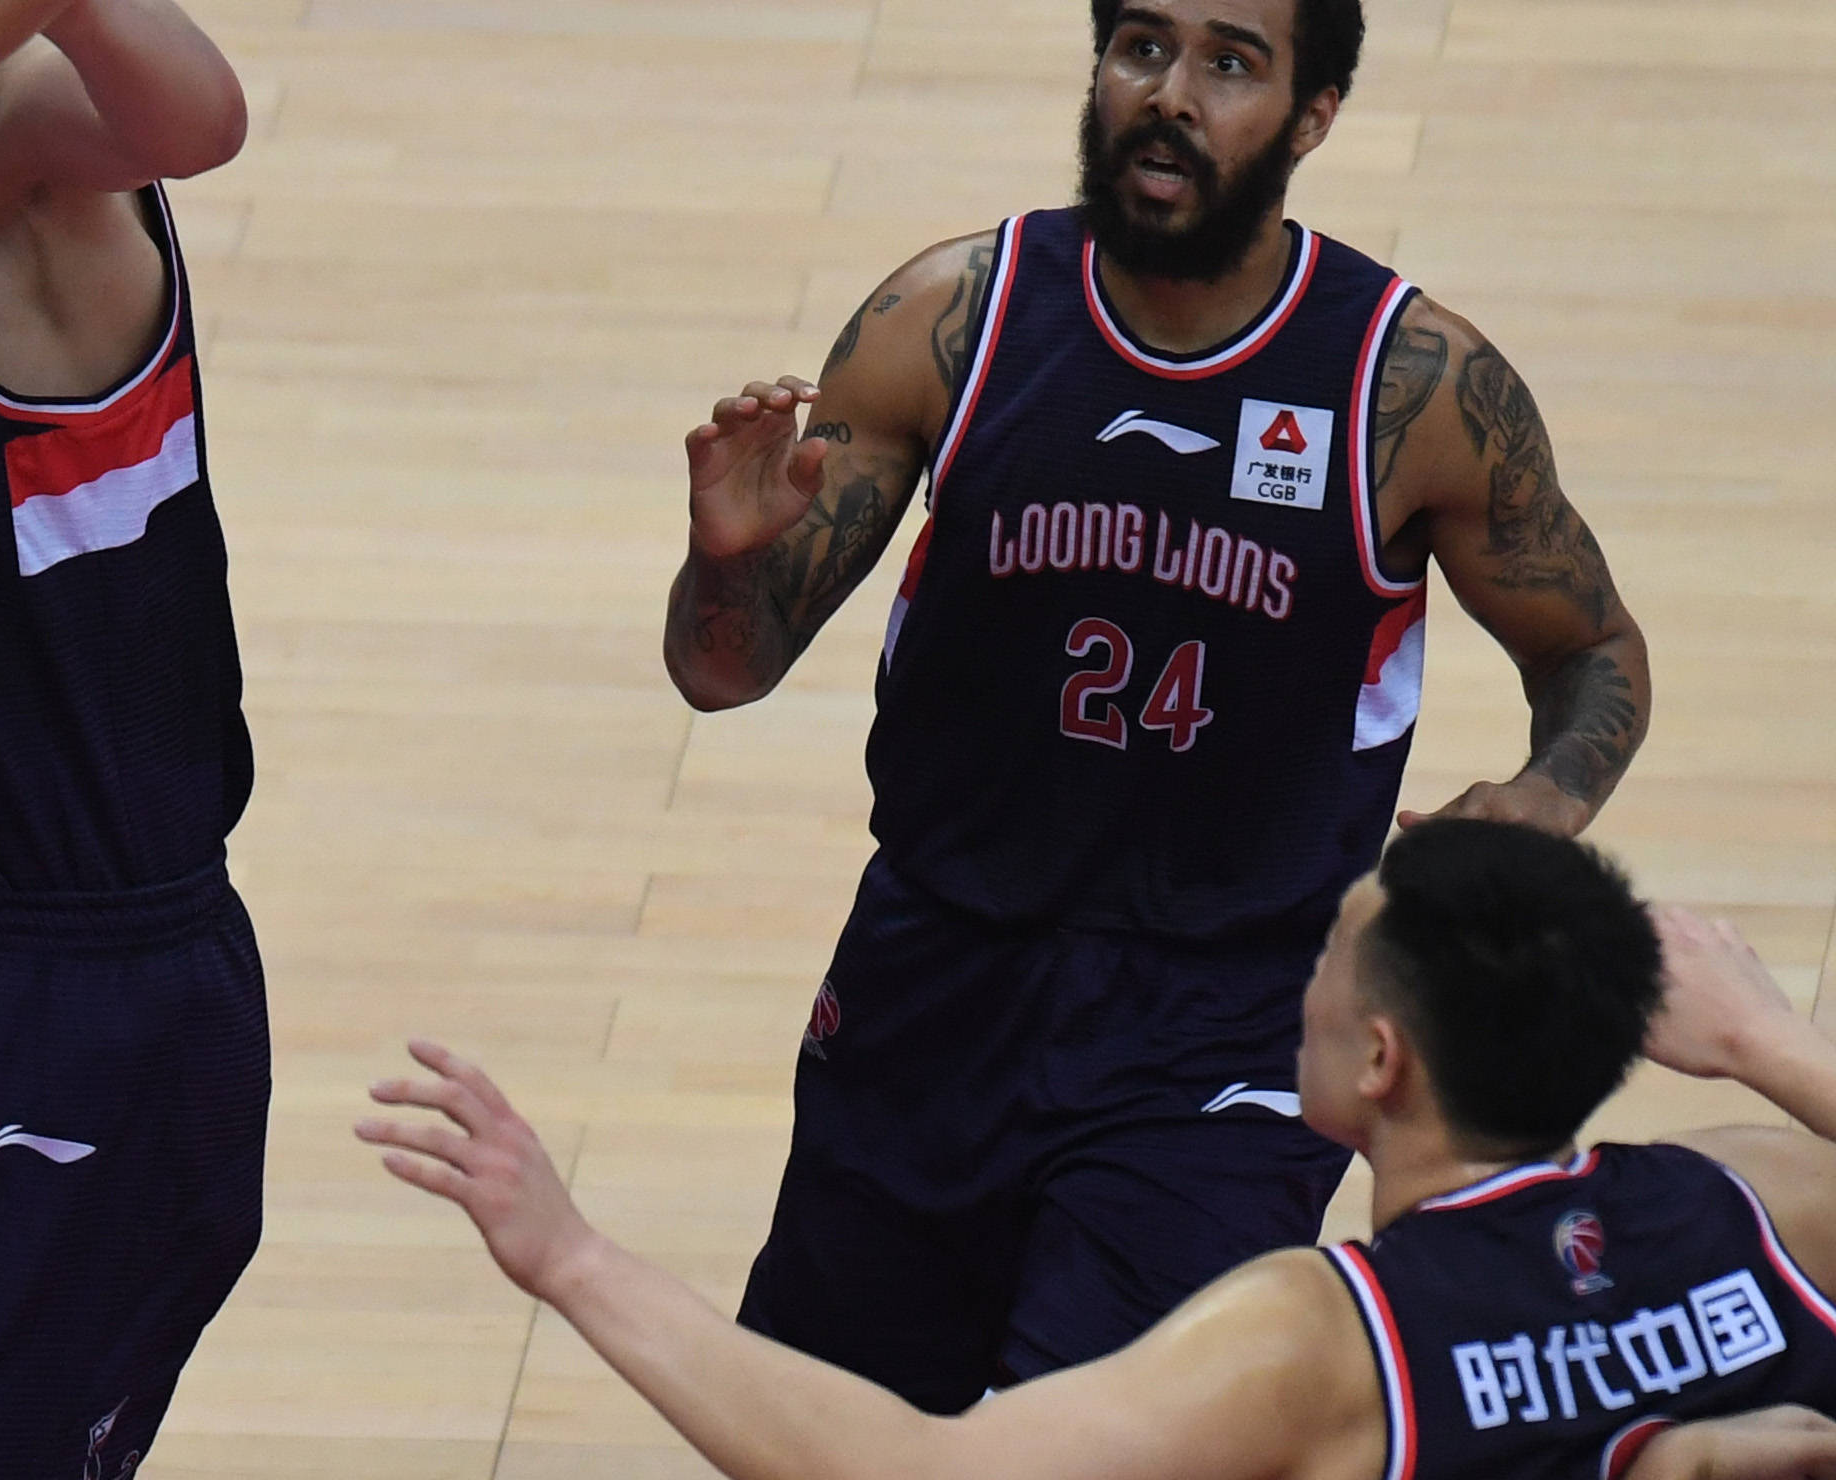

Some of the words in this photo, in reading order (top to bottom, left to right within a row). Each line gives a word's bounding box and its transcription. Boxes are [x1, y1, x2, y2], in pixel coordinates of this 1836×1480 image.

[1246, 461, 1313, 485] 广发银行
[1257, 481, 1297, 502] CGB
[988, 502, 1148, 580] LOONG
[1153, 510, 1300, 622] LIONS
[1059, 616, 1215, 753] 24
[1452, 1269, 1787, 1429] 时代中国
